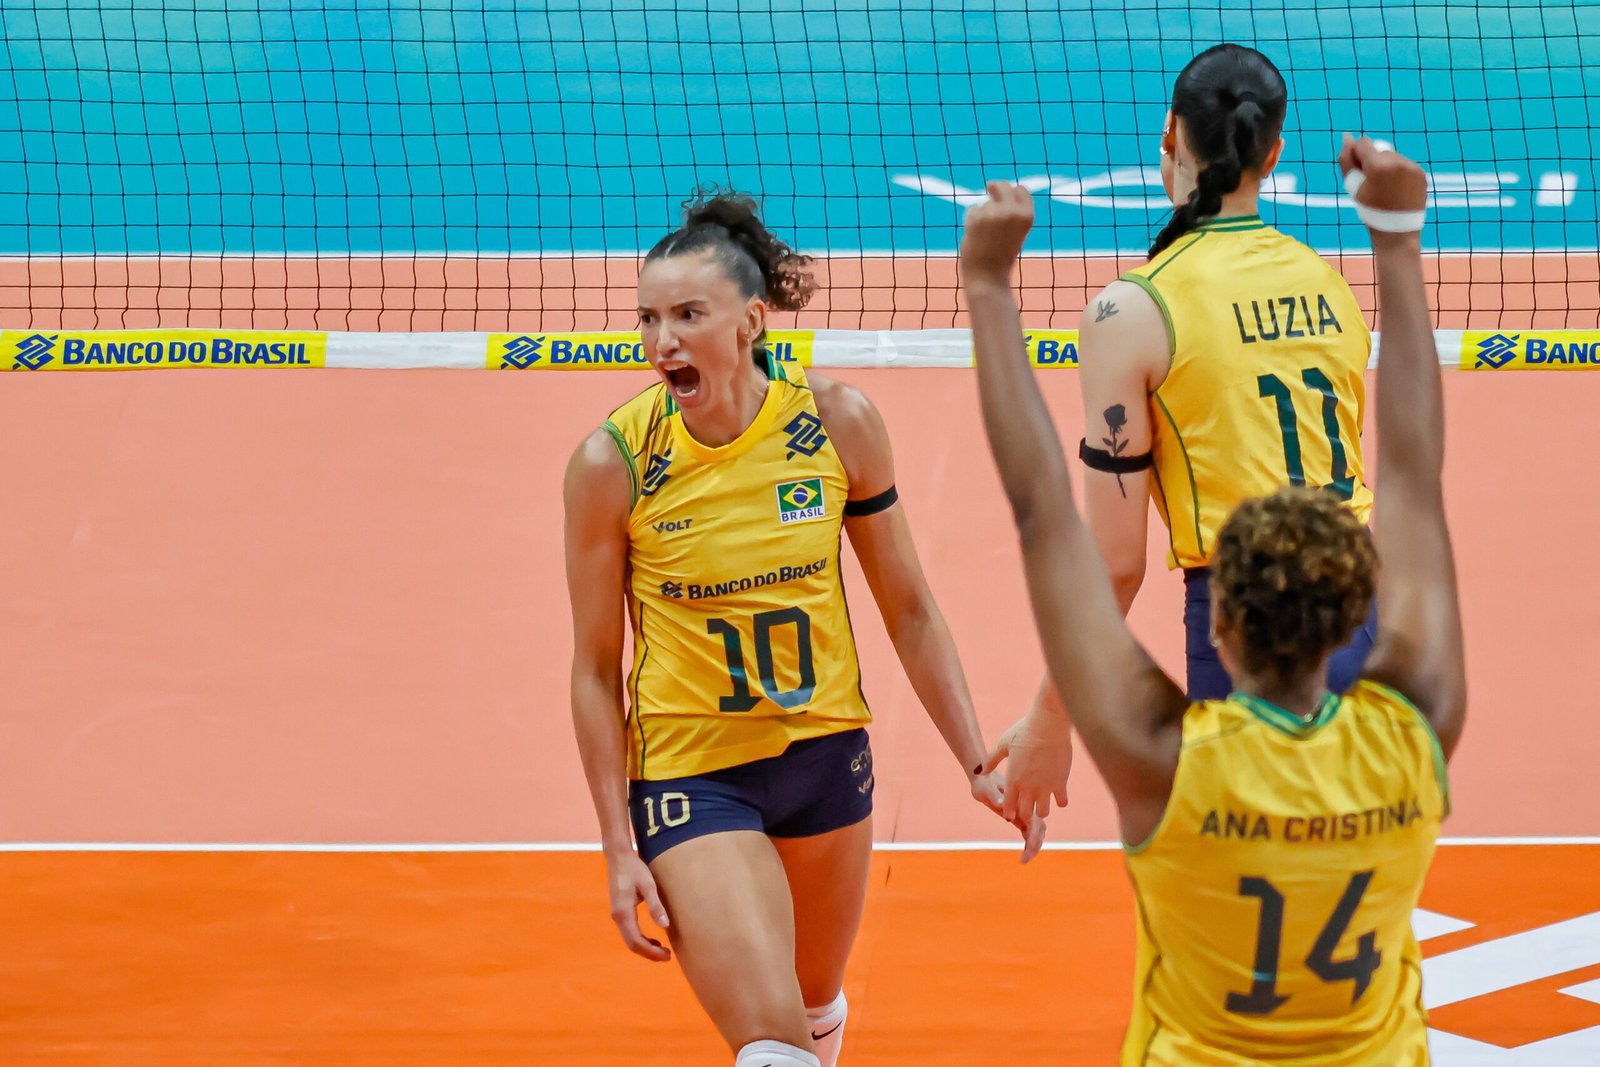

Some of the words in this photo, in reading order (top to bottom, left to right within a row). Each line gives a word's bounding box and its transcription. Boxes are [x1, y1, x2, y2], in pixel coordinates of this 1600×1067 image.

[1232, 293, 1343, 344] LUZIA
[63, 338, 164, 365] BANCO
[168, 341, 207, 364] DO
[210, 338, 311, 365] BRASIL
[1257, 366, 1356, 501] 11
[652, 518, 693, 534] VOLT
[781, 508, 824, 522] BRASIL
[687, 577, 751, 600] BANCO
[754, 572, 778, 588] DO
[779, 557, 828, 583] BRASIL
[706, 605, 817, 713] 10
[643, 792, 692, 838] 10
[1200, 809, 1273, 842] ANA
[1283, 796, 1425, 843] CRISTINA
[1223, 867, 1383, 1016] 14
